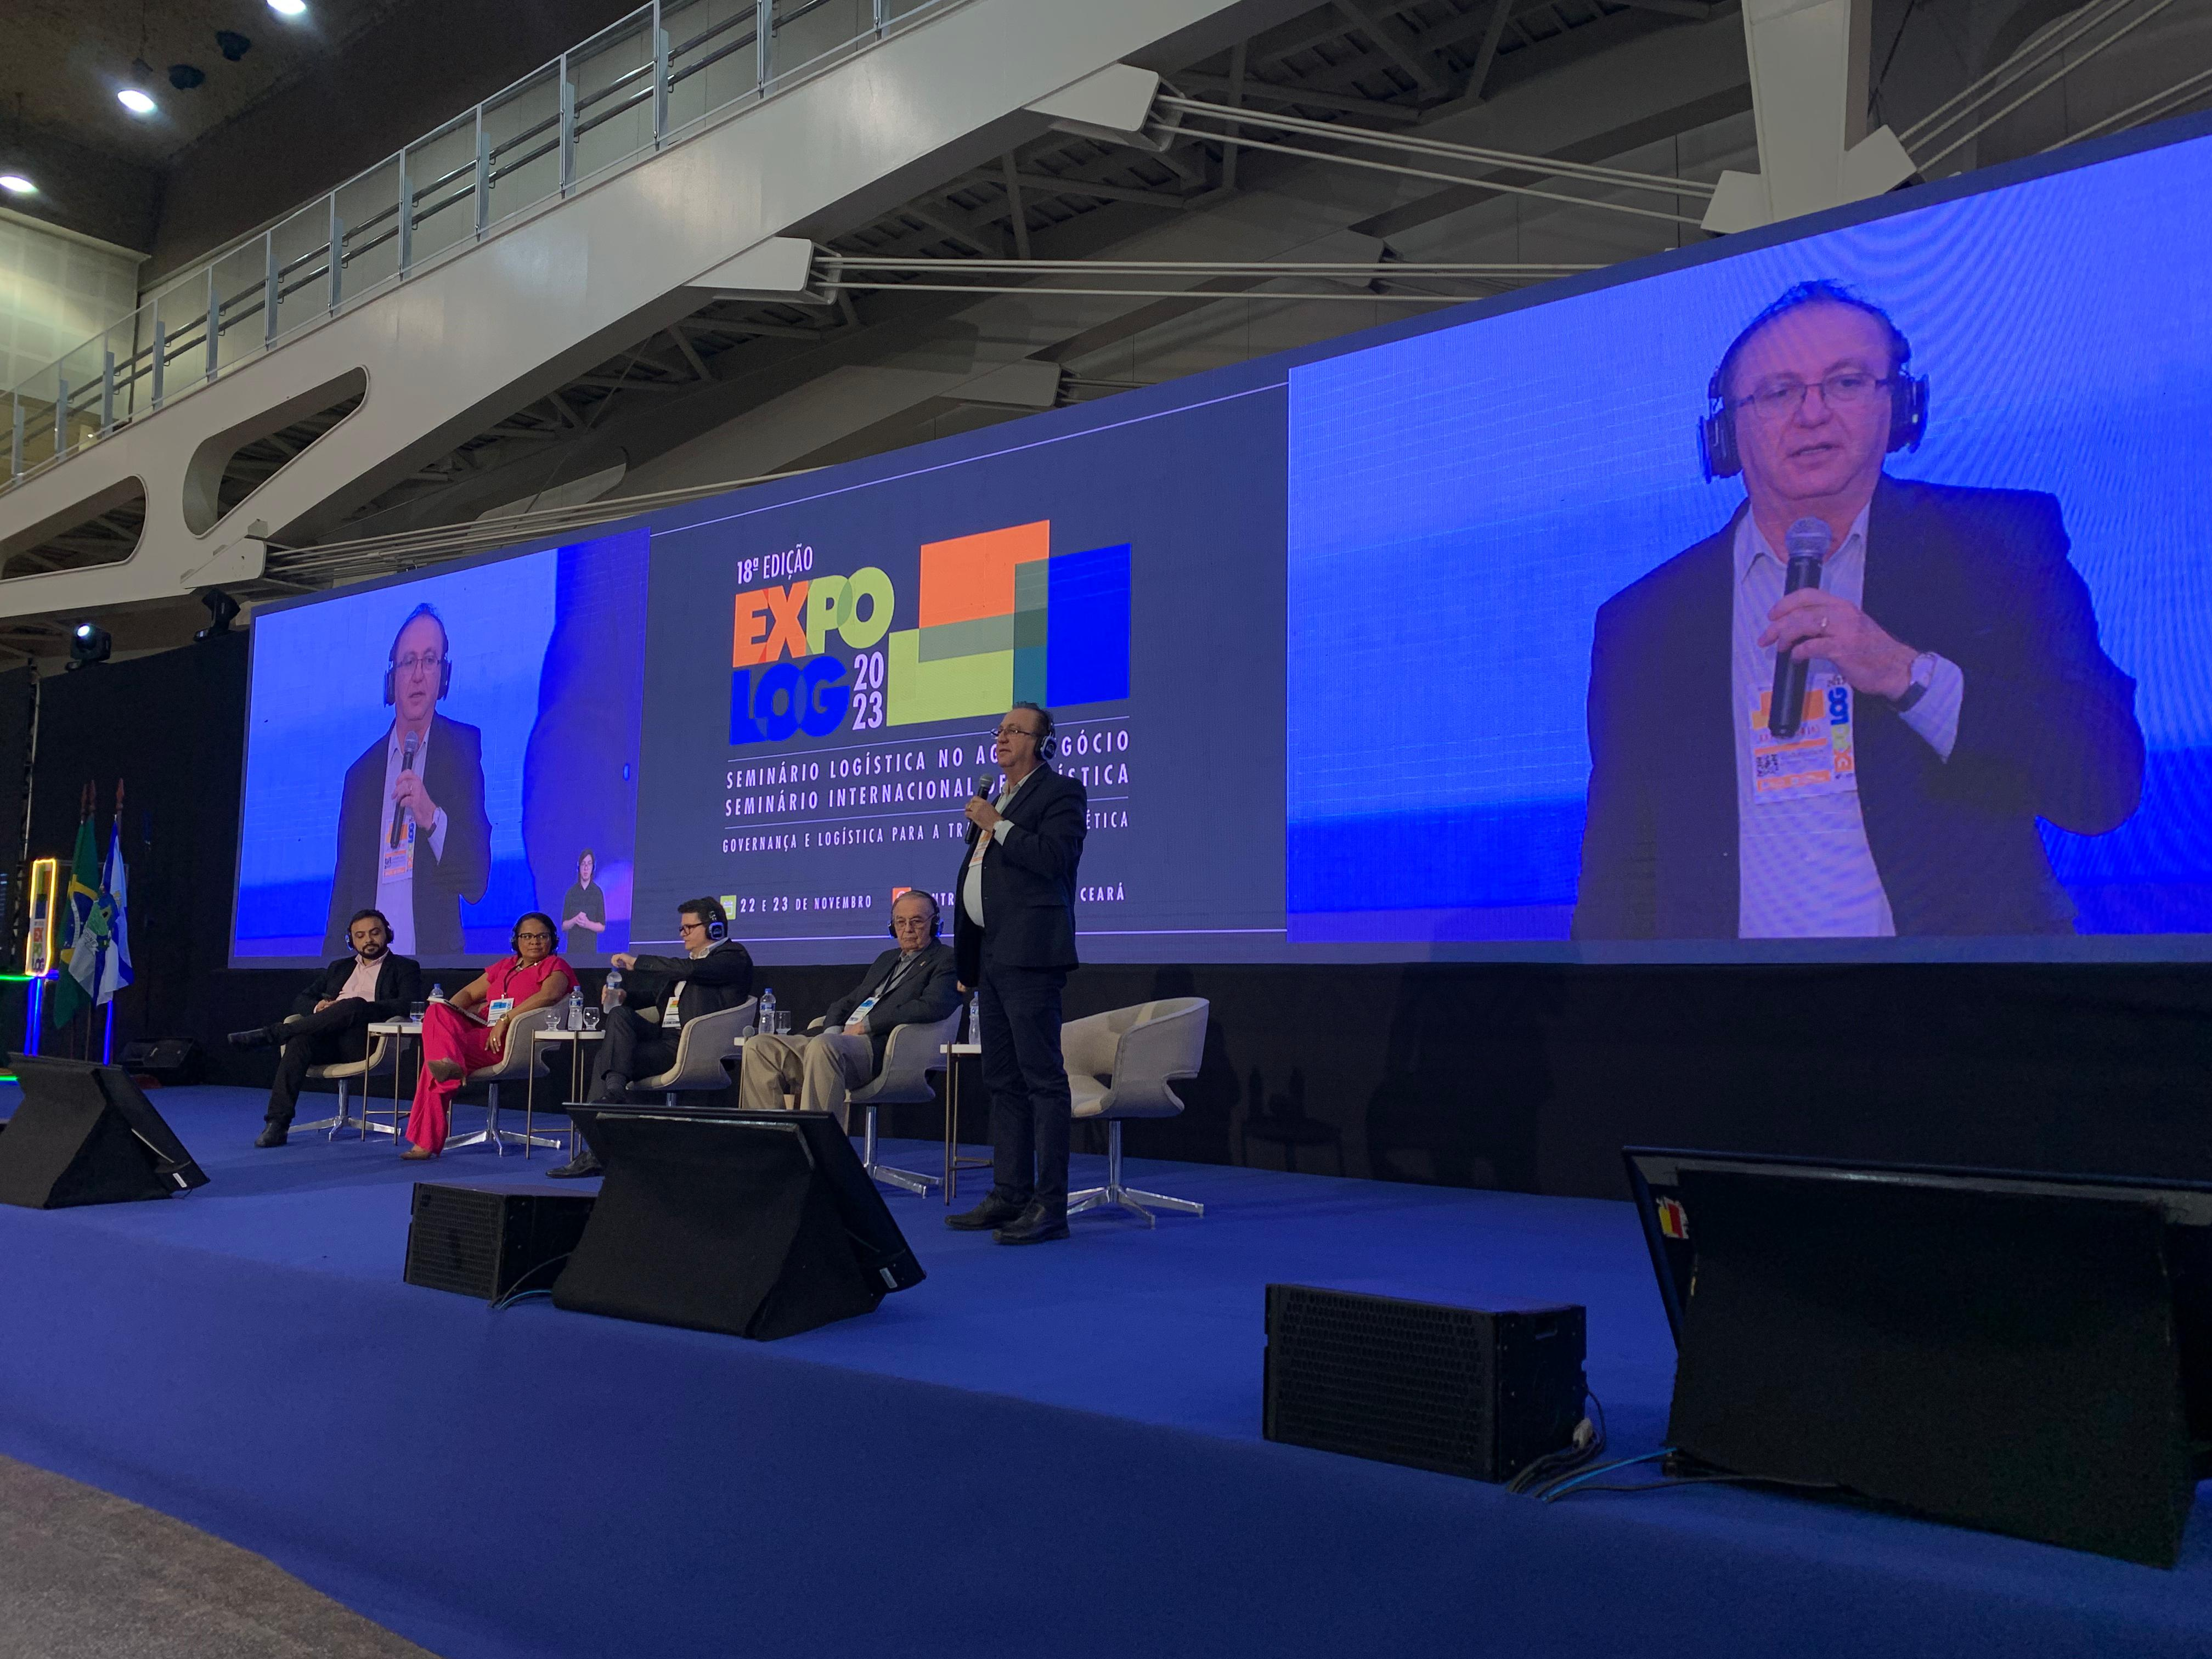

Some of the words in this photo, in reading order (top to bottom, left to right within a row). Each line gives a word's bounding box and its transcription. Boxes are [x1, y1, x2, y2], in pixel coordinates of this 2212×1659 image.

[763, 543, 813, 580] EDIÇÃO
[732, 567, 894, 668] EXPO
[853, 651, 884, 691] 20
[730, 656, 850, 746] LOG
[852, 691, 883, 730] 23
[726, 761, 819, 789] SEMINÁRIO
[830, 751, 925, 778] LOGÍSTICA
[939, 747, 963, 768] NO
[725, 789, 818, 817] SEMINÁRIO
[829, 777, 974, 808] INTERNACIONAL
[723, 834, 797, 853] GOVERNANÇA
[805, 833, 810, 848] E
[818, 826, 883, 847] LOGÍSTICA
[892, 825, 924, 842] PARA
[933, 824, 939, 839] A
[740, 898, 755, 913] 22
[761, 899, 766, 912] E
[773, 896, 788, 912] 23
[795, 898, 808, 911] DE
[814, 895, 871, 910] NOVEMBRO
[1080, 882, 1124, 902] CEARÁ
